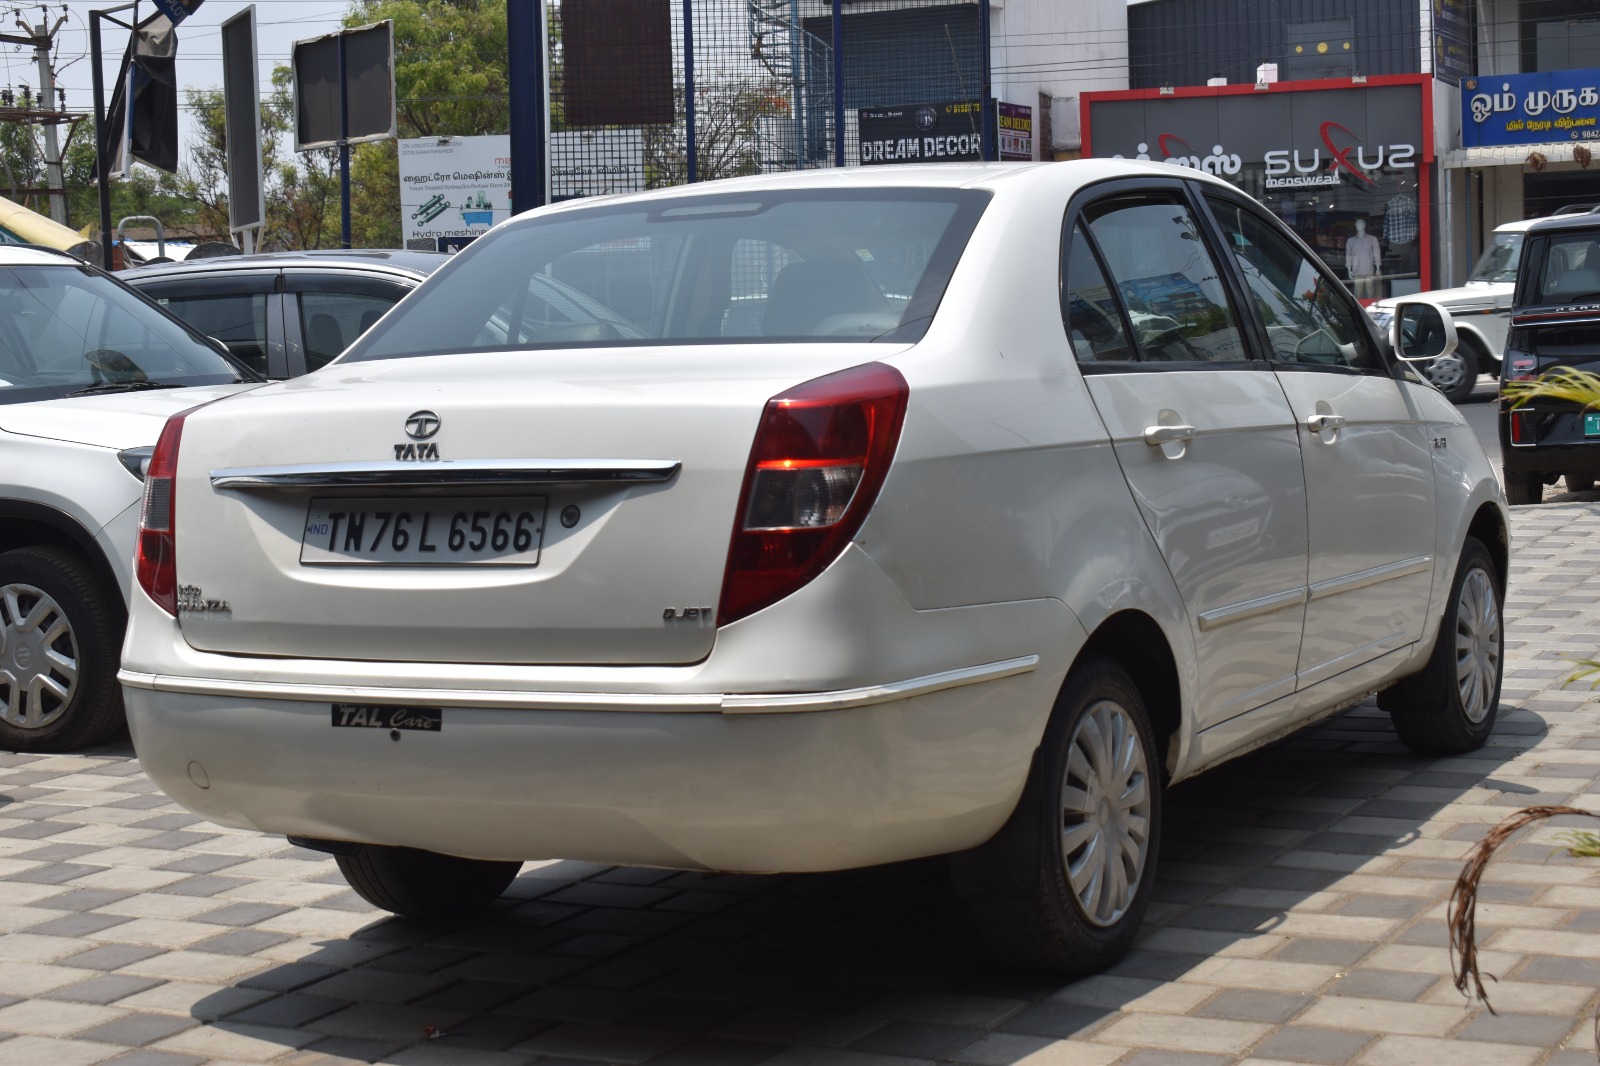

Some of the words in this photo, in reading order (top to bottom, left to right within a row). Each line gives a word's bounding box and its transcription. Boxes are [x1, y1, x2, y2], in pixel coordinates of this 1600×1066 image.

[1471, 83, 1516, 123] ஓம்
[1554, 116, 1597, 130] விற்பனை
[1582, 131, 1600, 140] 9842
[861, 138, 920, 161] DREAM
[413, 229, 442, 238] Hydro
[394, 442, 440, 461] TATA
[309, 524, 328, 535] IND
[340, 707, 382, 727] TAL
[389, 708, 434, 729] Care
